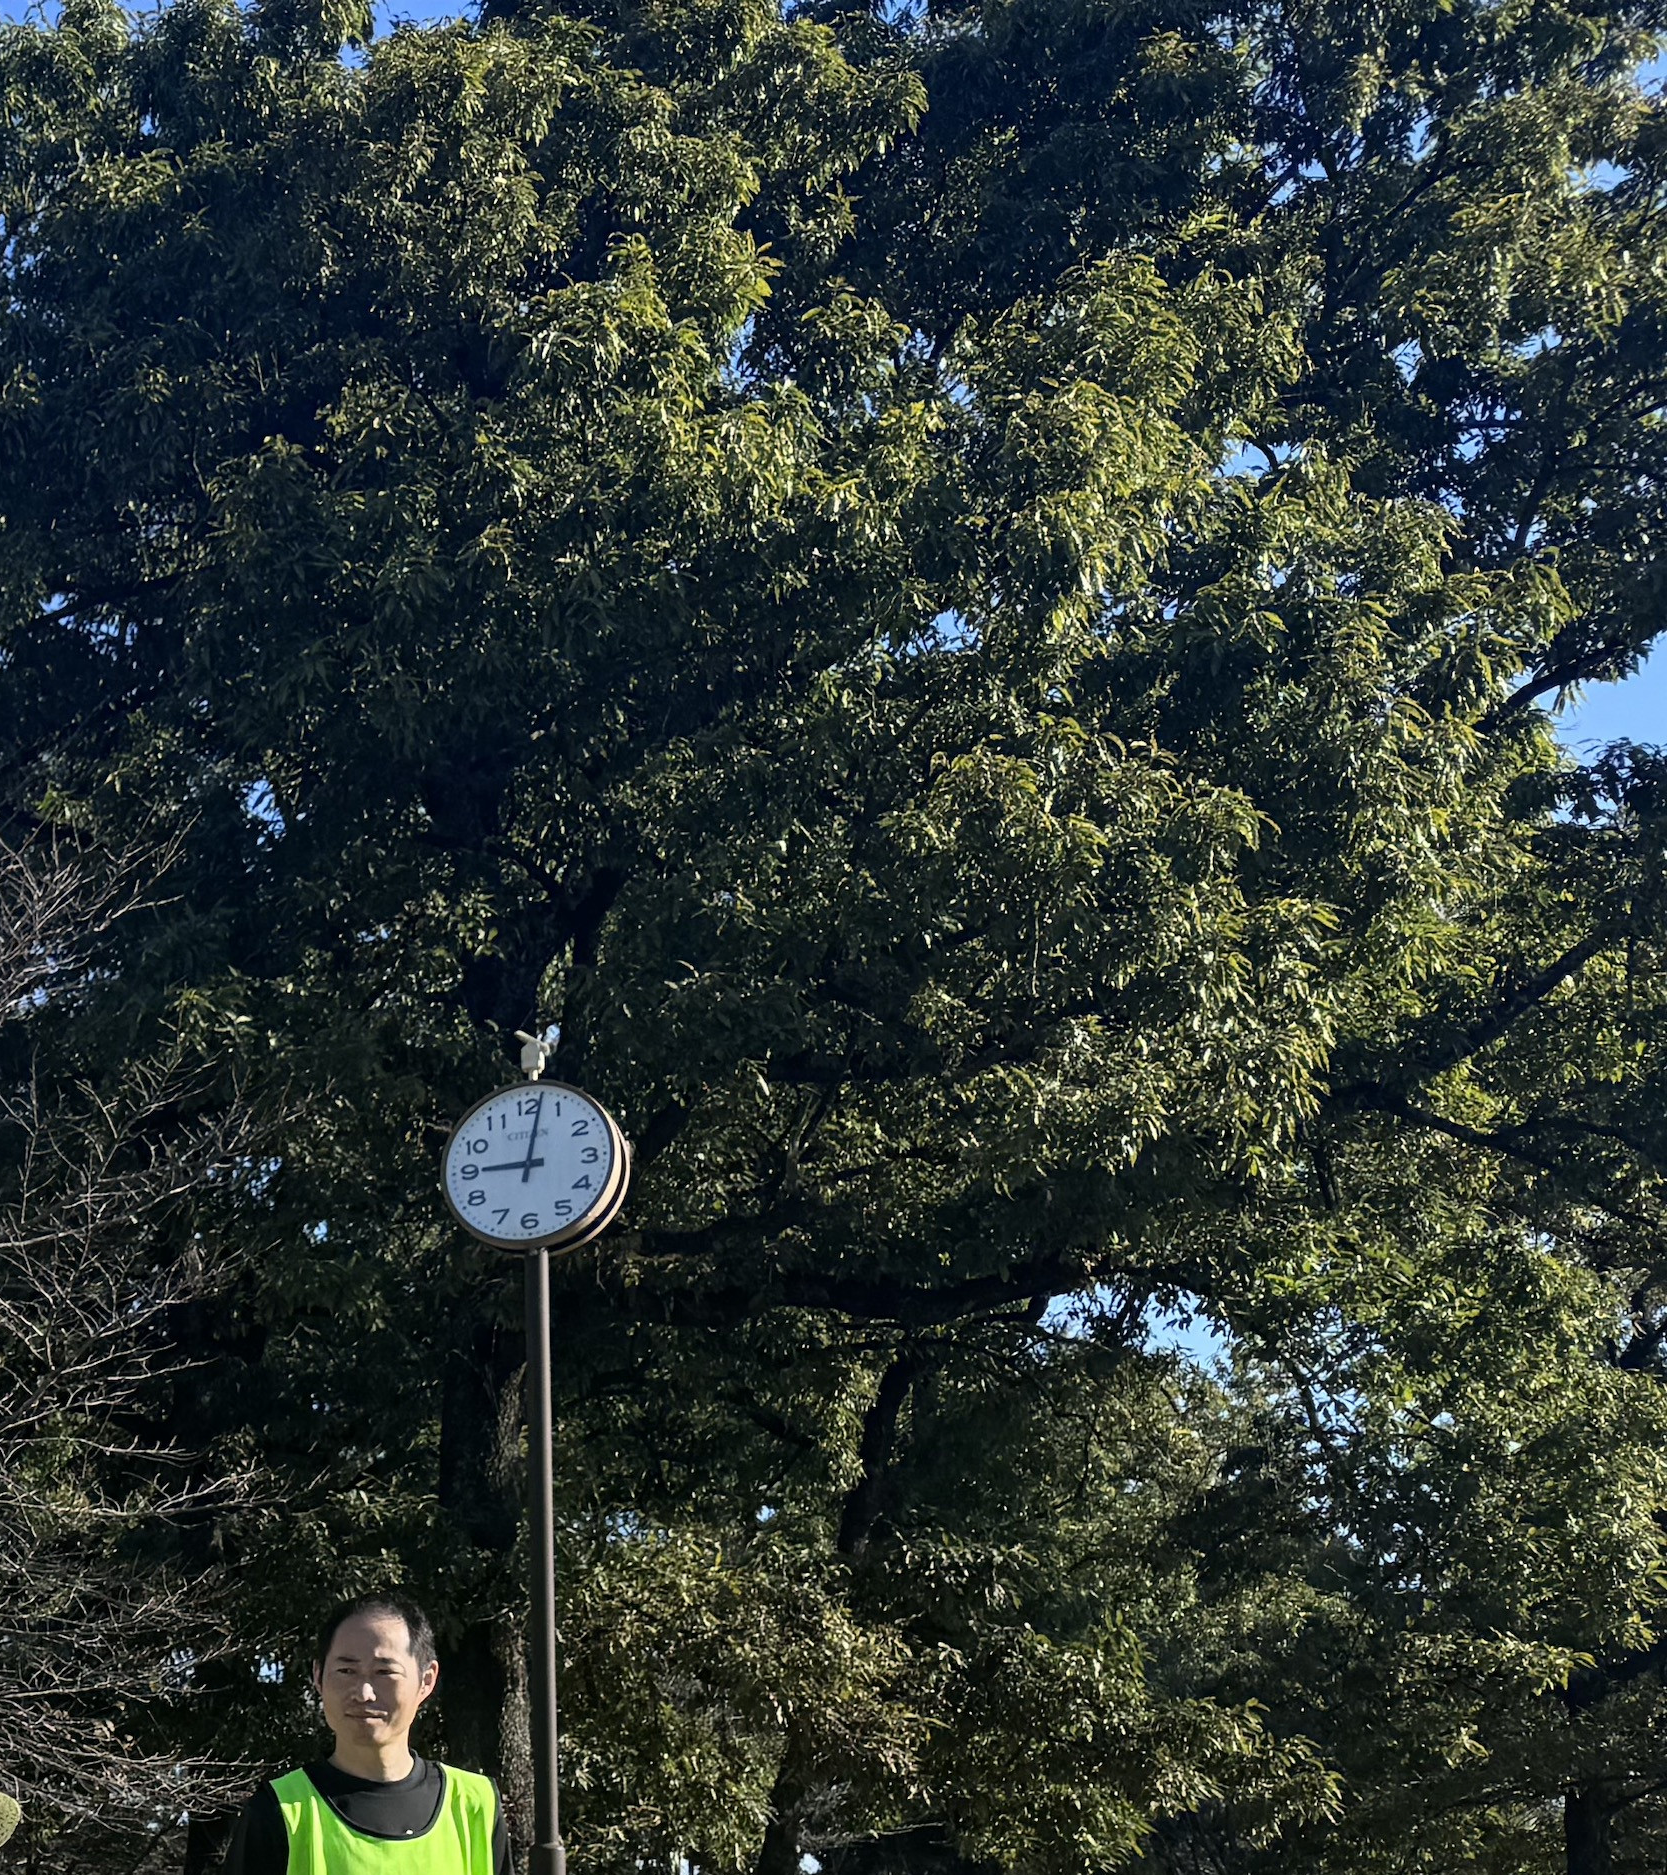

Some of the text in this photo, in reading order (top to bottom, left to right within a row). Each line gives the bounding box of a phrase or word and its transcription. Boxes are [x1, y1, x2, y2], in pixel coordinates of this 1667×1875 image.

[516, 1098, 541, 1116] 12
[554, 1101, 562, 1117] 1
[486, 1113, 506, 1131] 11
[571, 1119, 589, 1137] 2
[466, 1138, 489, 1155] 10
[581, 1147, 599, 1164] 3
[460, 1164, 480, 1180] 9
[571, 1174, 592, 1191] 4
[467, 1190, 486, 1206] 8
[554, 1199, 572, 1216] 5
[491, 1208, 510, 1226] 7
[520, 1212, 539, 1229] 6
